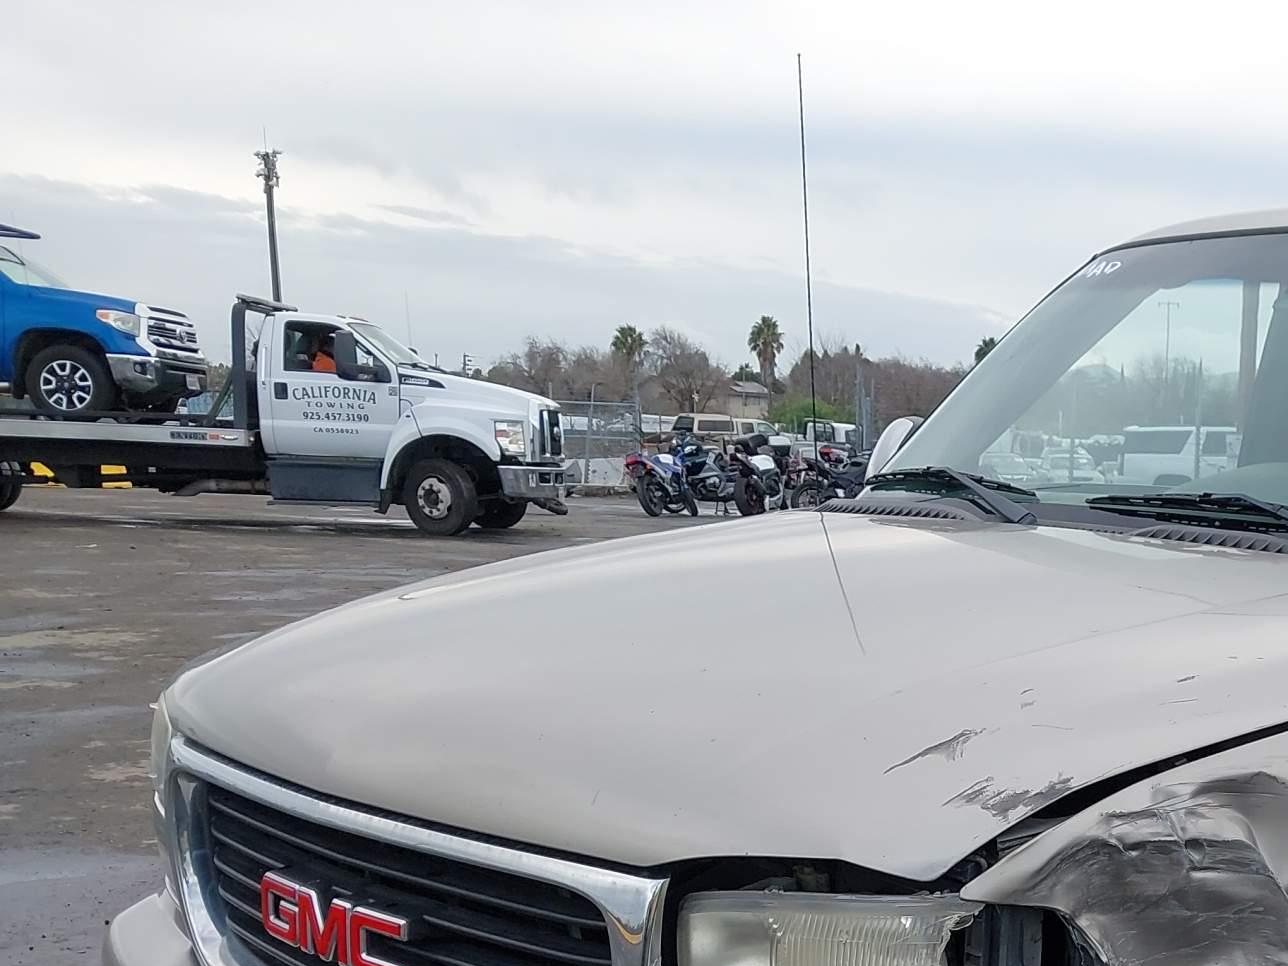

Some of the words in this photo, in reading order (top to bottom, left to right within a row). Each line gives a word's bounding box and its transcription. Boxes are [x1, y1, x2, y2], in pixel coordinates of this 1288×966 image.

[292, 385, 377, 404] CALIFORNIA
[305, 401, 366, 410] TOWING
[302, 411, 369, 422] 925.457.3190
